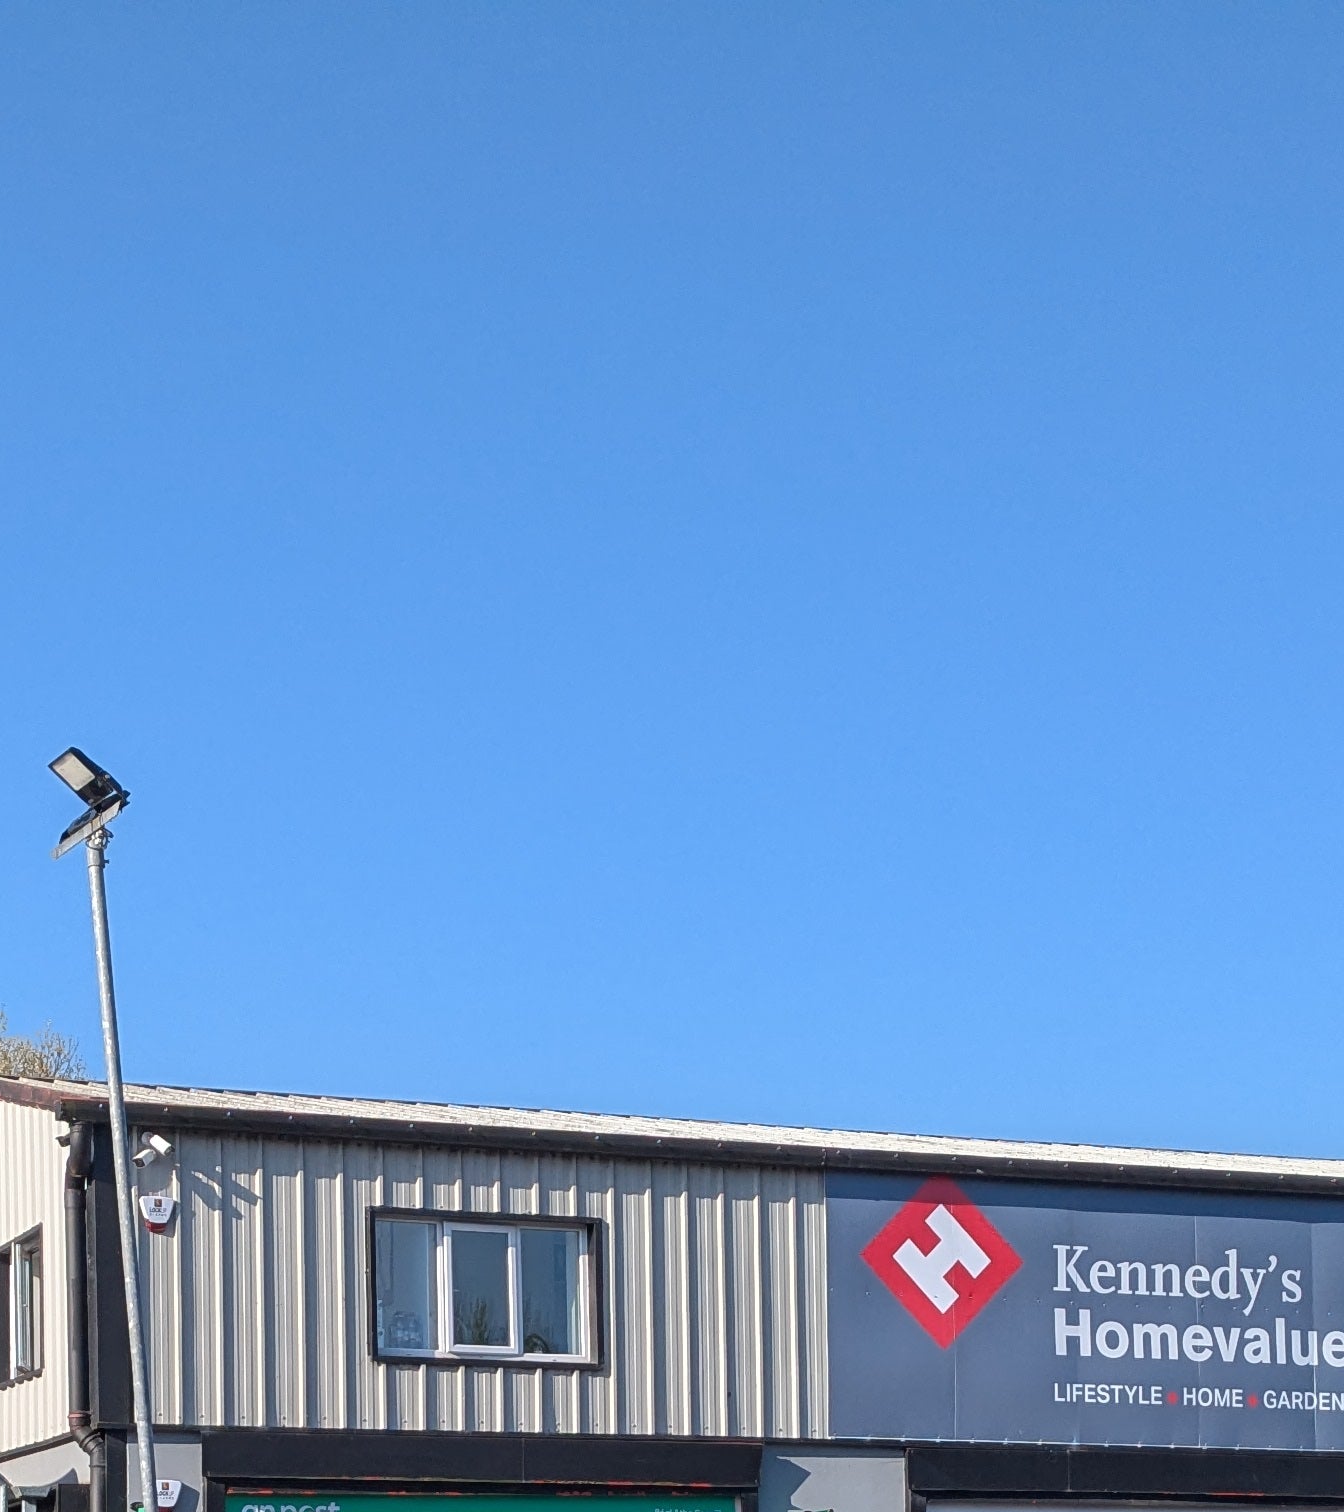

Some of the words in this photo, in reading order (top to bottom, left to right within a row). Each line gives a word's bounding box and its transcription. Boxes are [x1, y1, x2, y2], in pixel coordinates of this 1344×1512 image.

[1053, 1245, 1302, 1316] Kennedy's
[1054, 1383, 1162, 1405] LIFESTYLE
[1183, 1387, 1244, 1408] HOME
[1263, 1390, 1344, 1411] GARDEN
